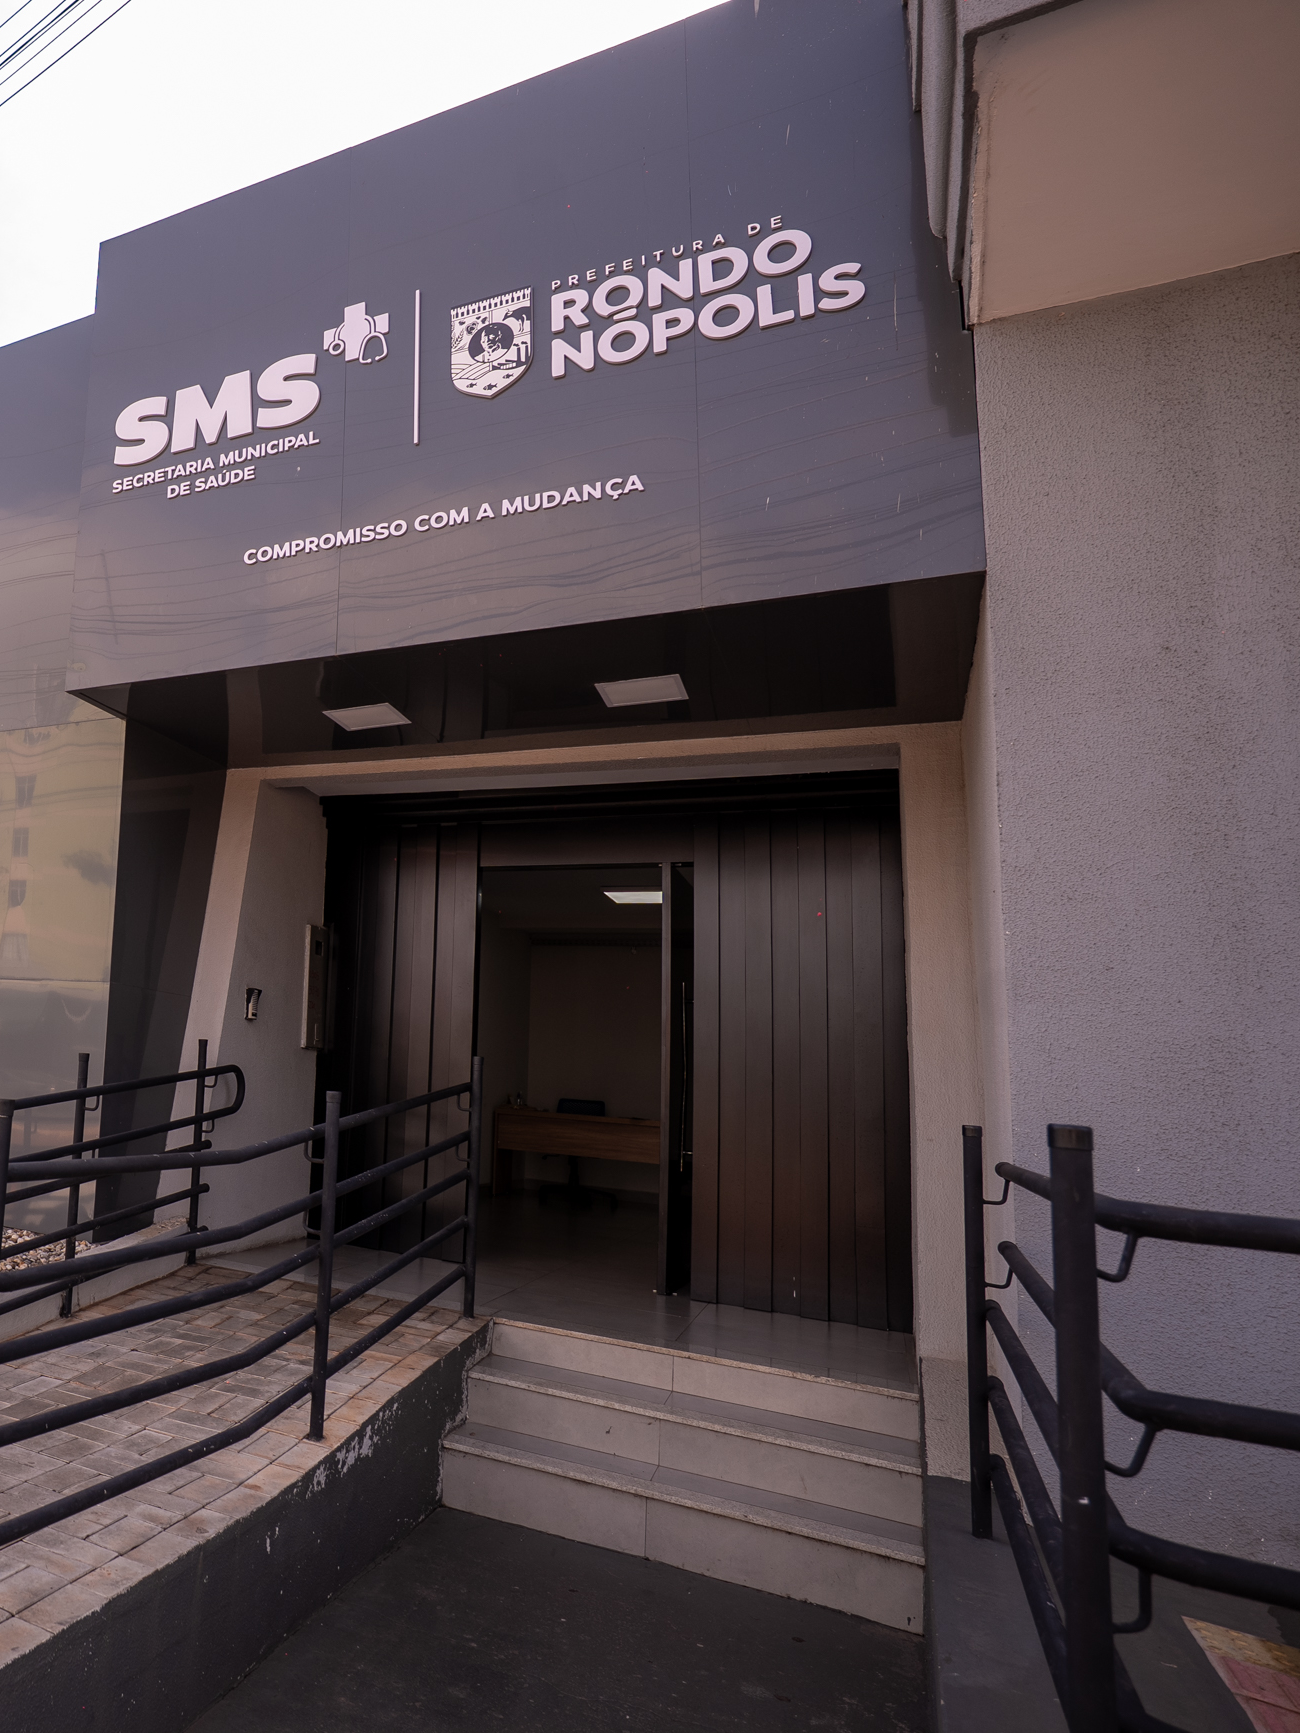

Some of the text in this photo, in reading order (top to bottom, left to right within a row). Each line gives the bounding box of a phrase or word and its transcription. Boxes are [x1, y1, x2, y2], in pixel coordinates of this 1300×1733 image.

[551, 215, 782, 290] PREFEITURA DE
[551, 229, 812, 333] RONDO
[551, 262, 866, 379] NÓPOLIS
[113, 353, 321, 466] SMS
[111, 431, 320, 494] SECRETARIA MUNICIPAL
[167, 465, 256, 499] DE SAÚDE
[243, 474, 645, 566] COMPROMISSO COM A MUDANÇA
